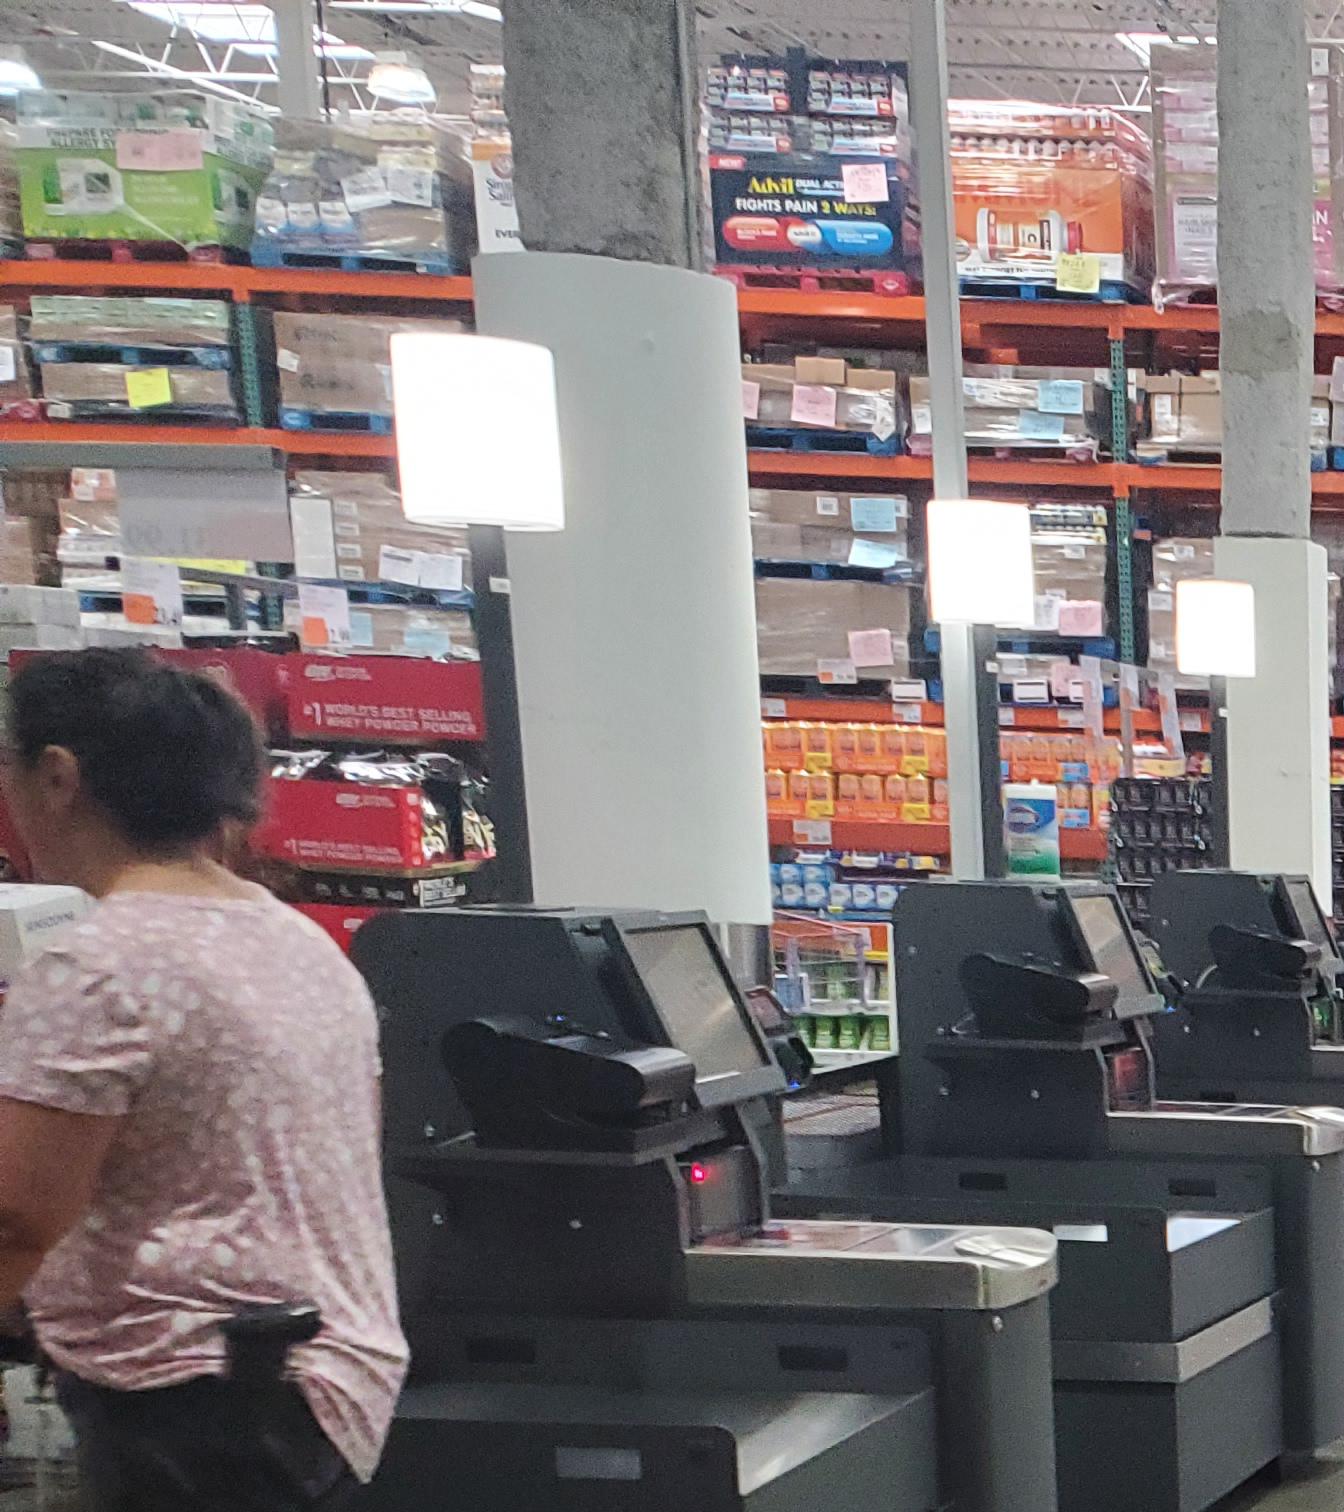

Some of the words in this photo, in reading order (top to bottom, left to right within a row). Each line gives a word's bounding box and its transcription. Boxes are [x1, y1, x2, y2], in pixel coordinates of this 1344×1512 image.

[749, 177, 795, 194] Advil
[736, 198, 781, 212] FIGHTS
[785, 201, 817, 213] PAIN
[835, 203, 876, 216] WAYS!
